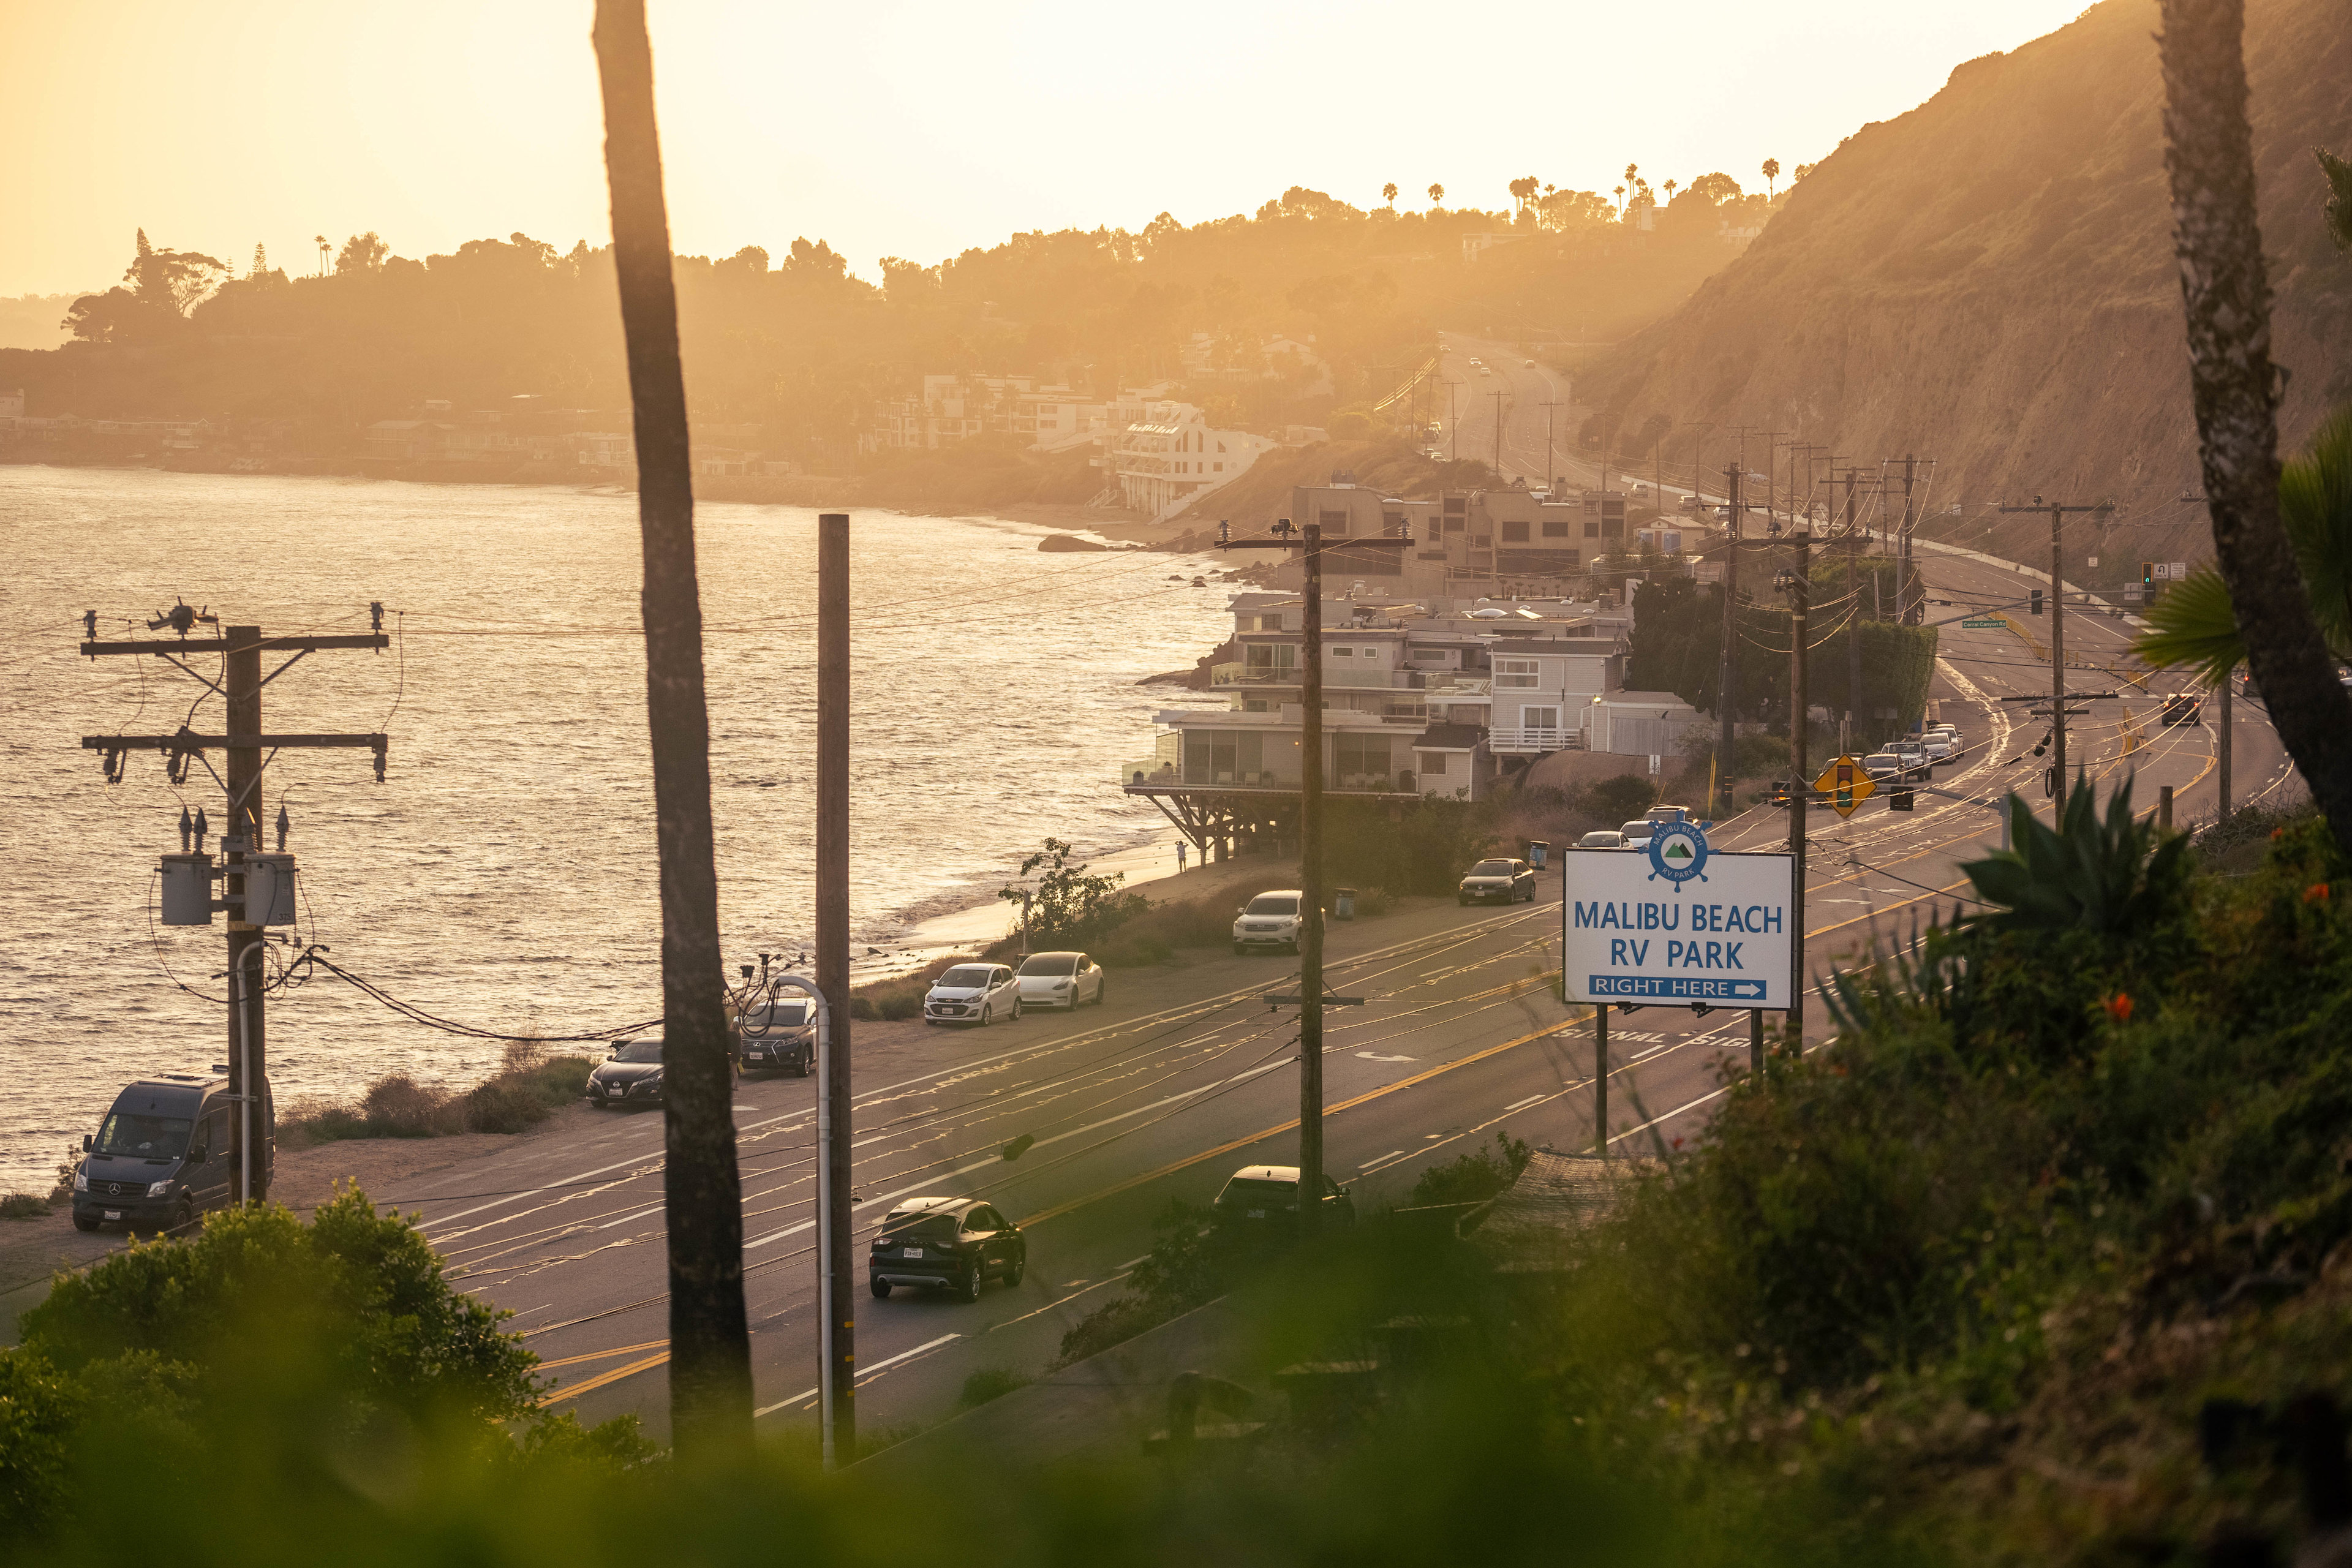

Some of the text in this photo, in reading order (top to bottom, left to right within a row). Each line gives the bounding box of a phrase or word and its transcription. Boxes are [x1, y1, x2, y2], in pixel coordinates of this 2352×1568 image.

[1654, 825, 1703, 846] MALIBU BEACH
[1662, 867, 1695, 878] RV PARK
[1575, 901, 1782, 933] MALIBU BEACH
[1611, 938, 1744, 969] RV PARK
[1595, 978, 1728, 996] RIGHT HERE
